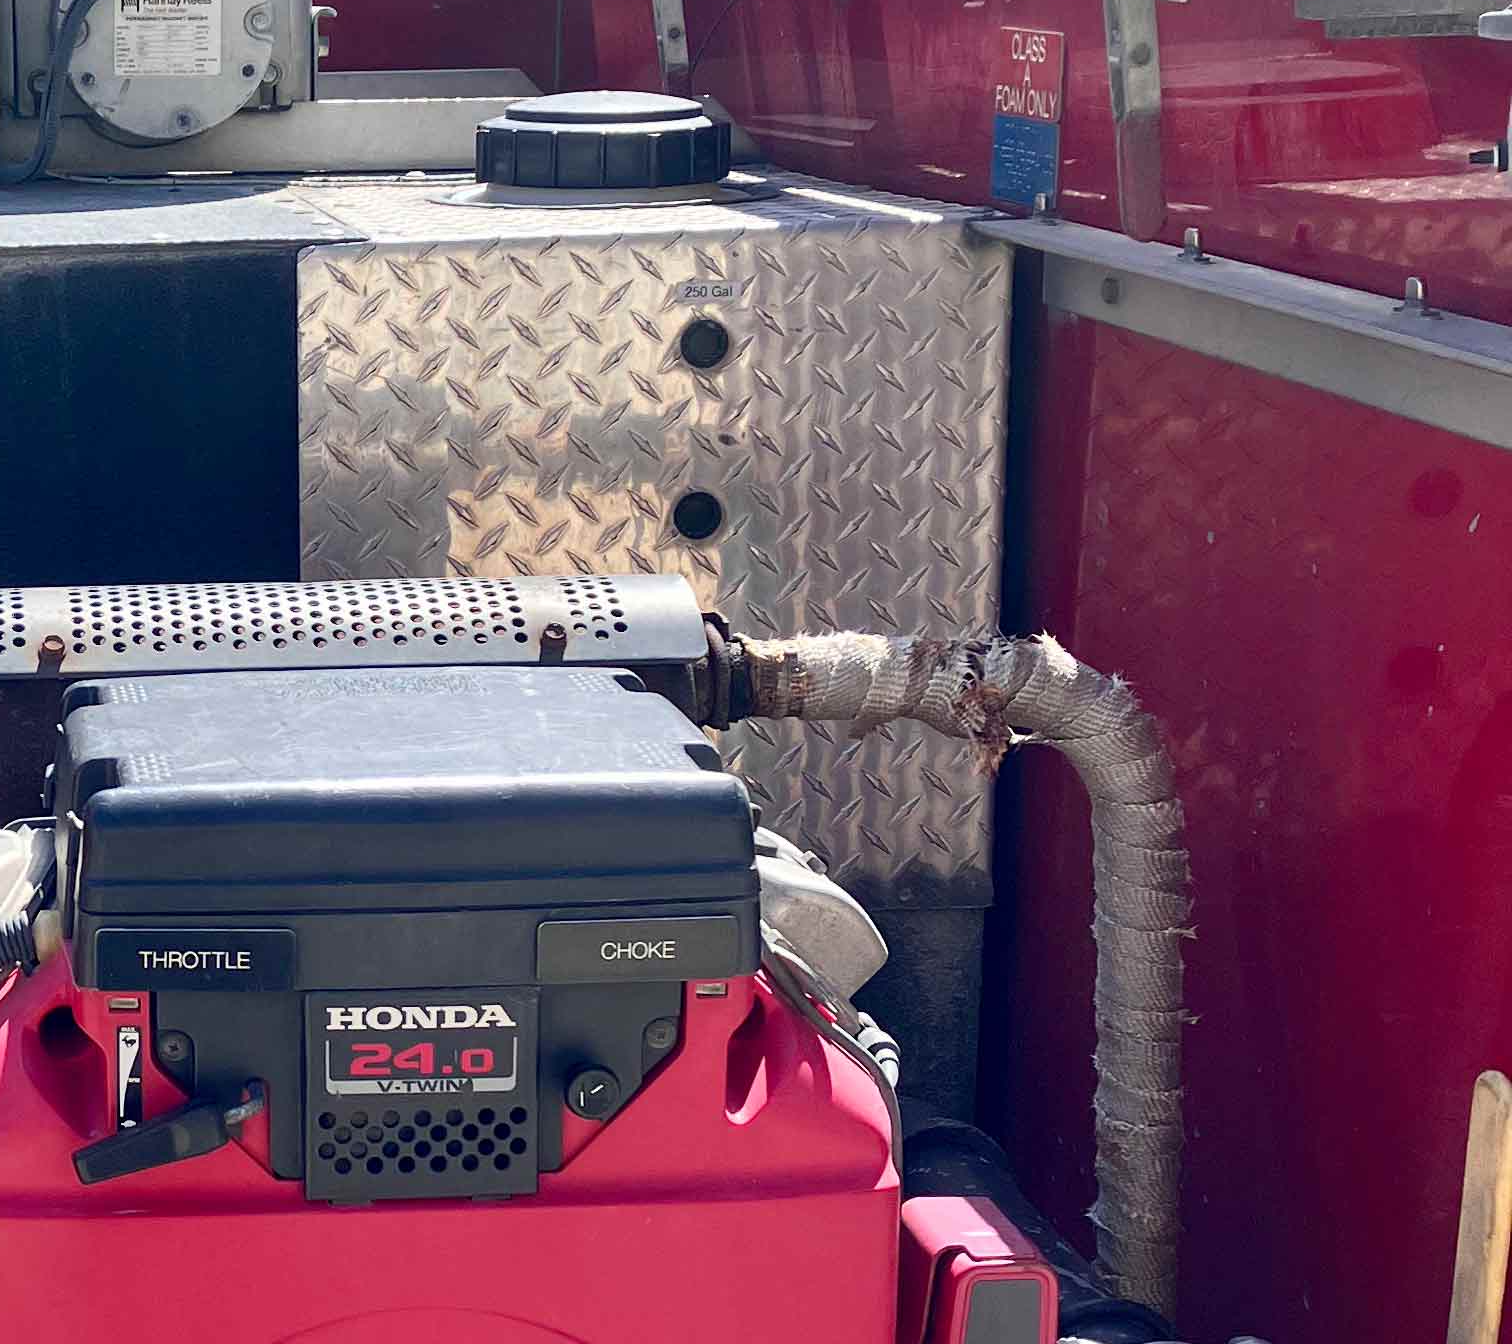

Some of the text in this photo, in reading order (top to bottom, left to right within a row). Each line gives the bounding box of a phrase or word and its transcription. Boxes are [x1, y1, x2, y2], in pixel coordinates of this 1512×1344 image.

[1011, 32, 1046, 63] CLASS
[1023, 61, 1032, 88] A
[995, 84, 1058, 119] FOAM ONLY
[684, 285, 733, 298] 250 Gal
[138, 950, 251, 969] THROTTLE
[600, 940, 676, 960] CHOKE
[326, 1004, 517, 1031] HONDA
[349, 1042, 495, 1076] 24.0
[376, 1078, 463, 1094] V-TWIN
